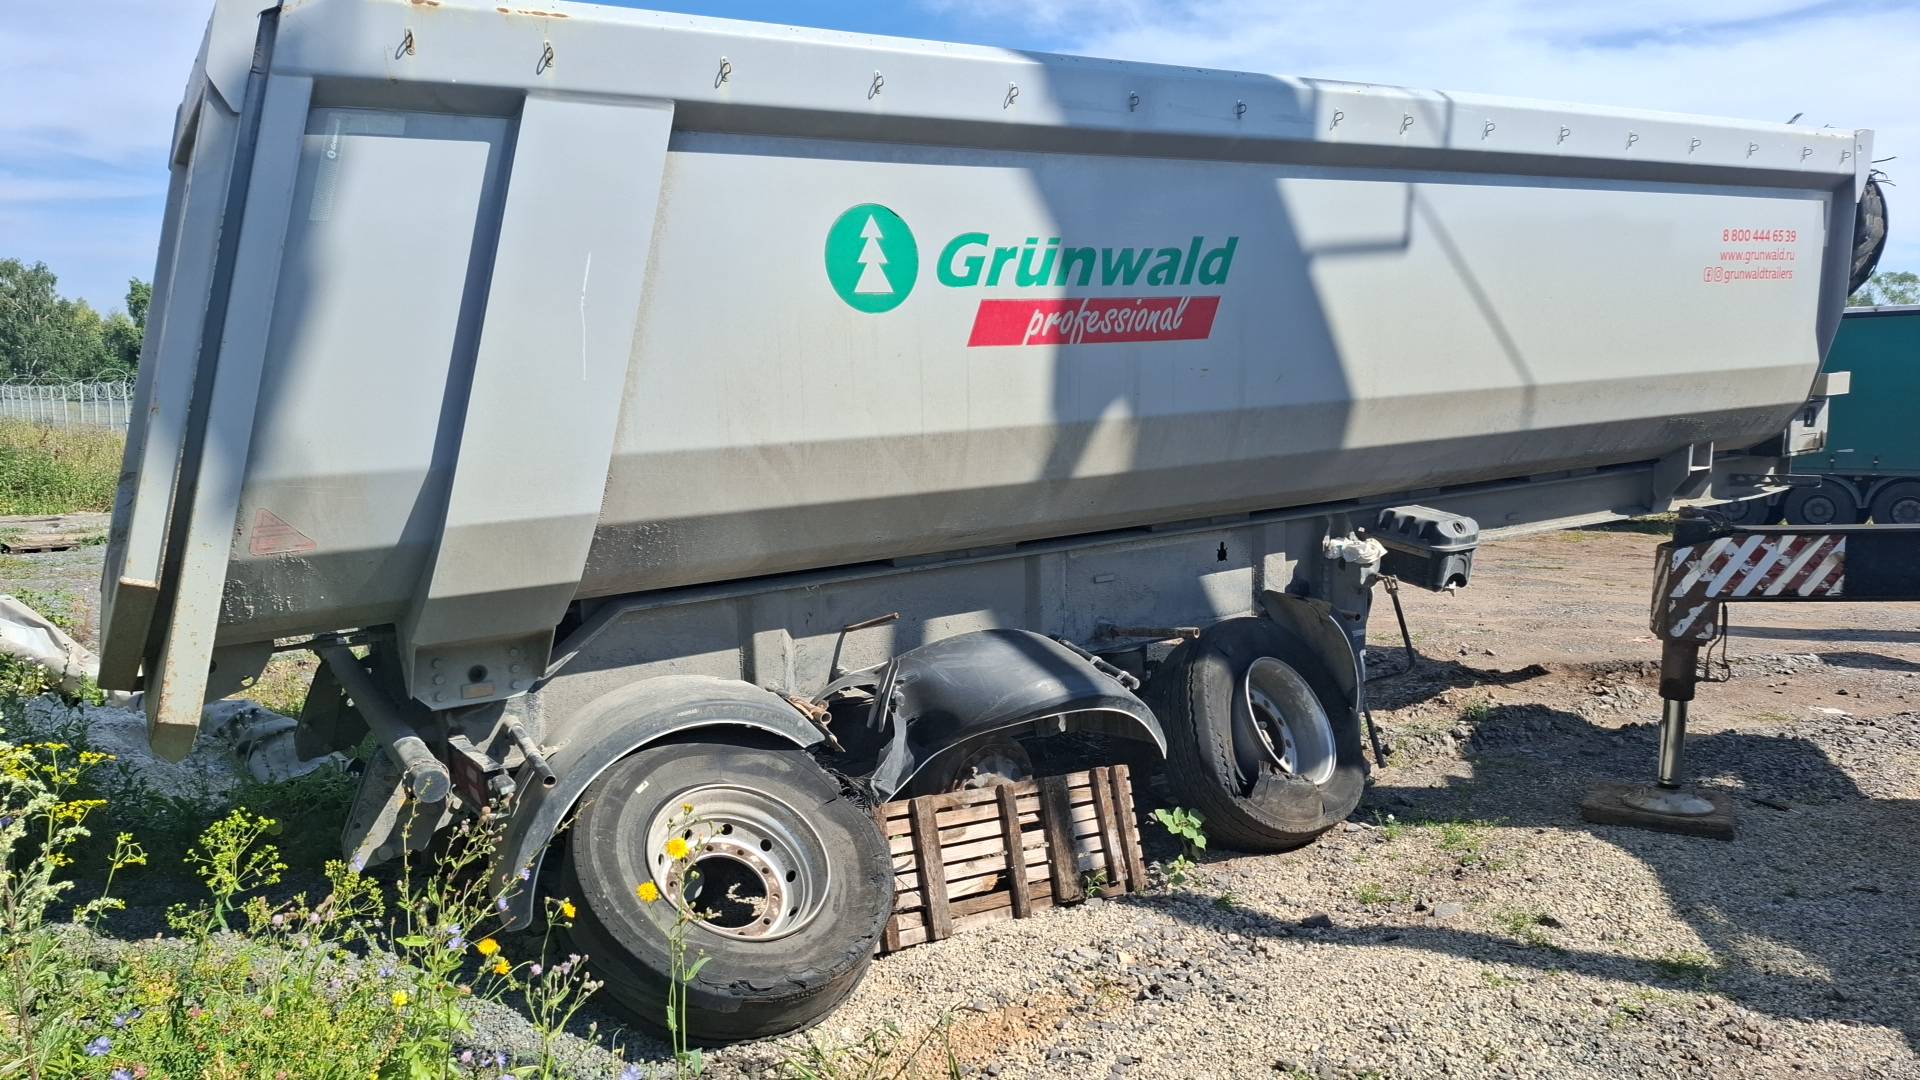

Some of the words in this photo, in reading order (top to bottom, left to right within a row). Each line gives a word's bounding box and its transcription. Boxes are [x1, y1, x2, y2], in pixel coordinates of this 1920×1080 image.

[1723, 229, 1729, 241] 8
[1731, 229, 1751, 242] 800
[1753, 229, 1770, 241] 444
[936, 232, 1240, 288] Grünwald
[1720, 248, 1795, 264] www.grunwald.ru
[1724, 266, 1793, 283] grunwaldtrailers
[1022, 296, 1190, 346] professional
